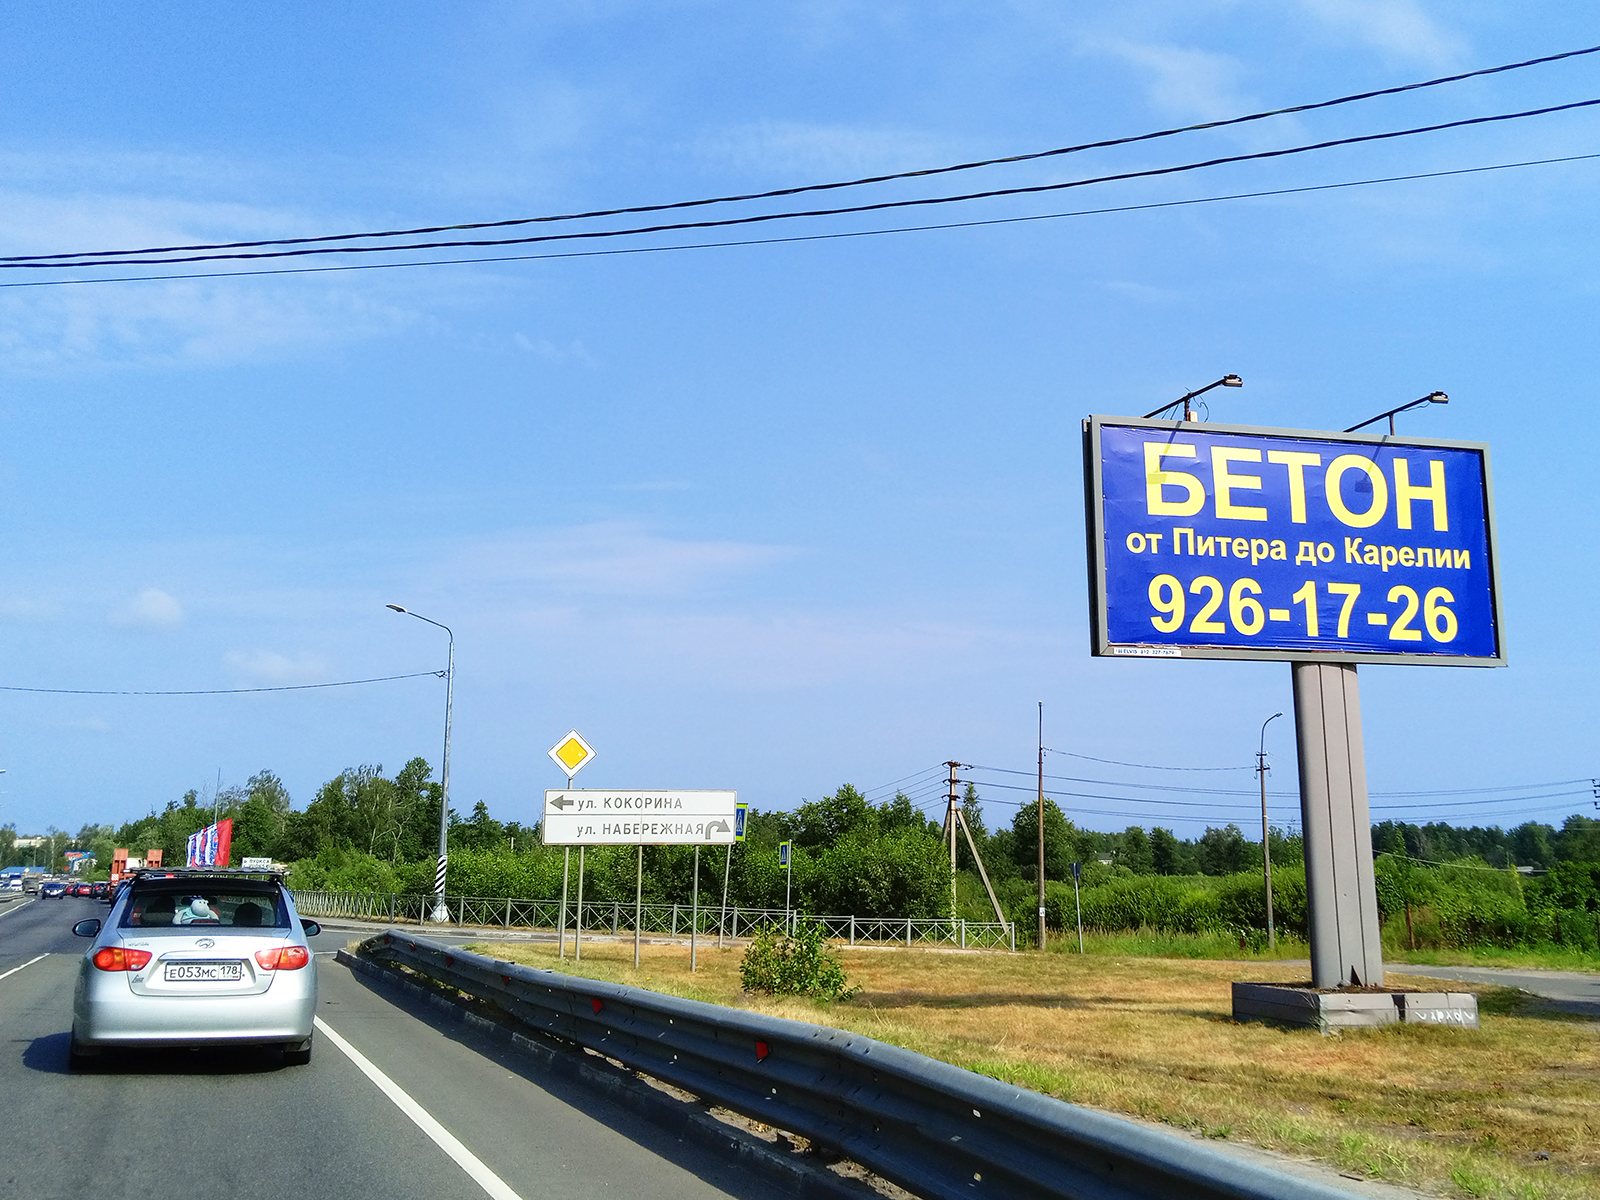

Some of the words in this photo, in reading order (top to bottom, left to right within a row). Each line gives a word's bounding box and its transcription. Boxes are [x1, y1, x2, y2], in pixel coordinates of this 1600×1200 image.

[1142, 440, 1449, 533] БЕТОН
[1126, 531, 1163, 555] от
[1173, 527, 1287, 566] Питера
[1295, 540, 1335, 567] до
[1345, 537, 1471, 572] Карелии
[1147, 573, 1459, 644] 926-17-26
[577, 799, 597, 811] ул.
[603, 797, 683, 809] КОКОРИНА
[576, 825, 596, 838] ул.
[602, 823, 704, 835] НАБЕРЕЖНАЯ
[220, 965, 238, 975] 178
